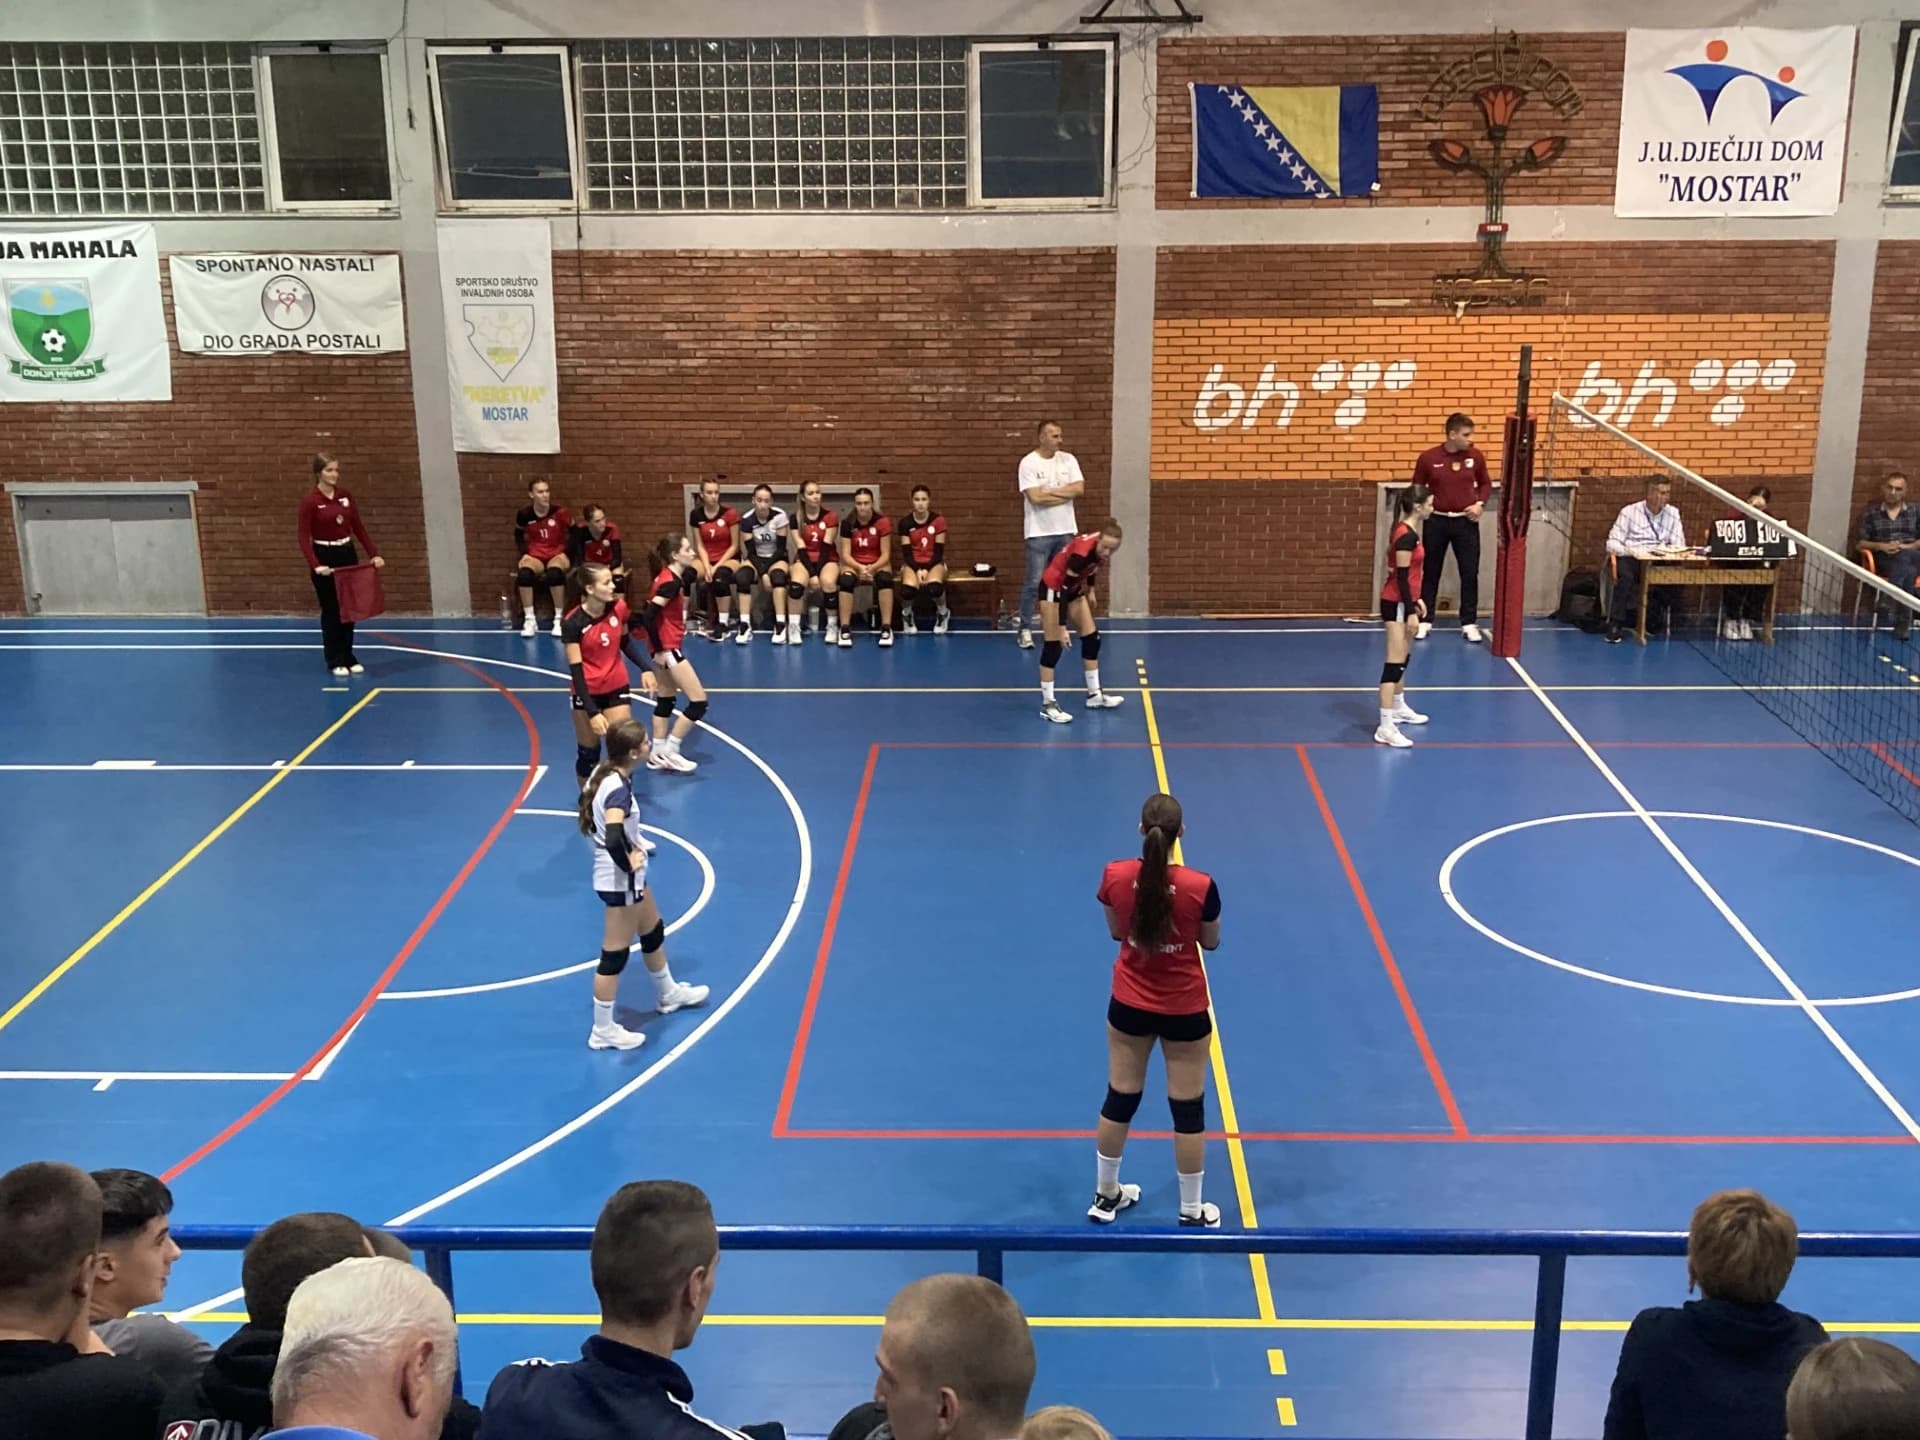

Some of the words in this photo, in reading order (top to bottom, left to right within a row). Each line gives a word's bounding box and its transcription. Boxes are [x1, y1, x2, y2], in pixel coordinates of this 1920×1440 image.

[1638, 135, 1763, 162] J.U.DJEČIJI
[1771, 140, 1824, 161] DOM
[1659, 173, 1801, 202] "MOSTAR"
[30, 239, 138, 259] MAHALA
[195, 257, 294, 273] SPONTANO
[299, 258, 375, 272] NASTALI
[455, 277, 499, 287] SPORTSKO
[501, 276, 539, 287] DRUŠTVO
[460, 289, 505, 298] INVALIDNIH
[506, 289, 535, 298] OSOBA
[203, 335, 234, 349] DIO
[239, 335, 301, 349] GRADA
[306, 334, 381, 348] POSTALI
[482, 406, 528, 421] MOSTAR
[540, 528, 549, 539] 11
[811, 532, 818, 542] 2
[921, 537, 928, 547] 9
[600, 632, 610, 647] 5
